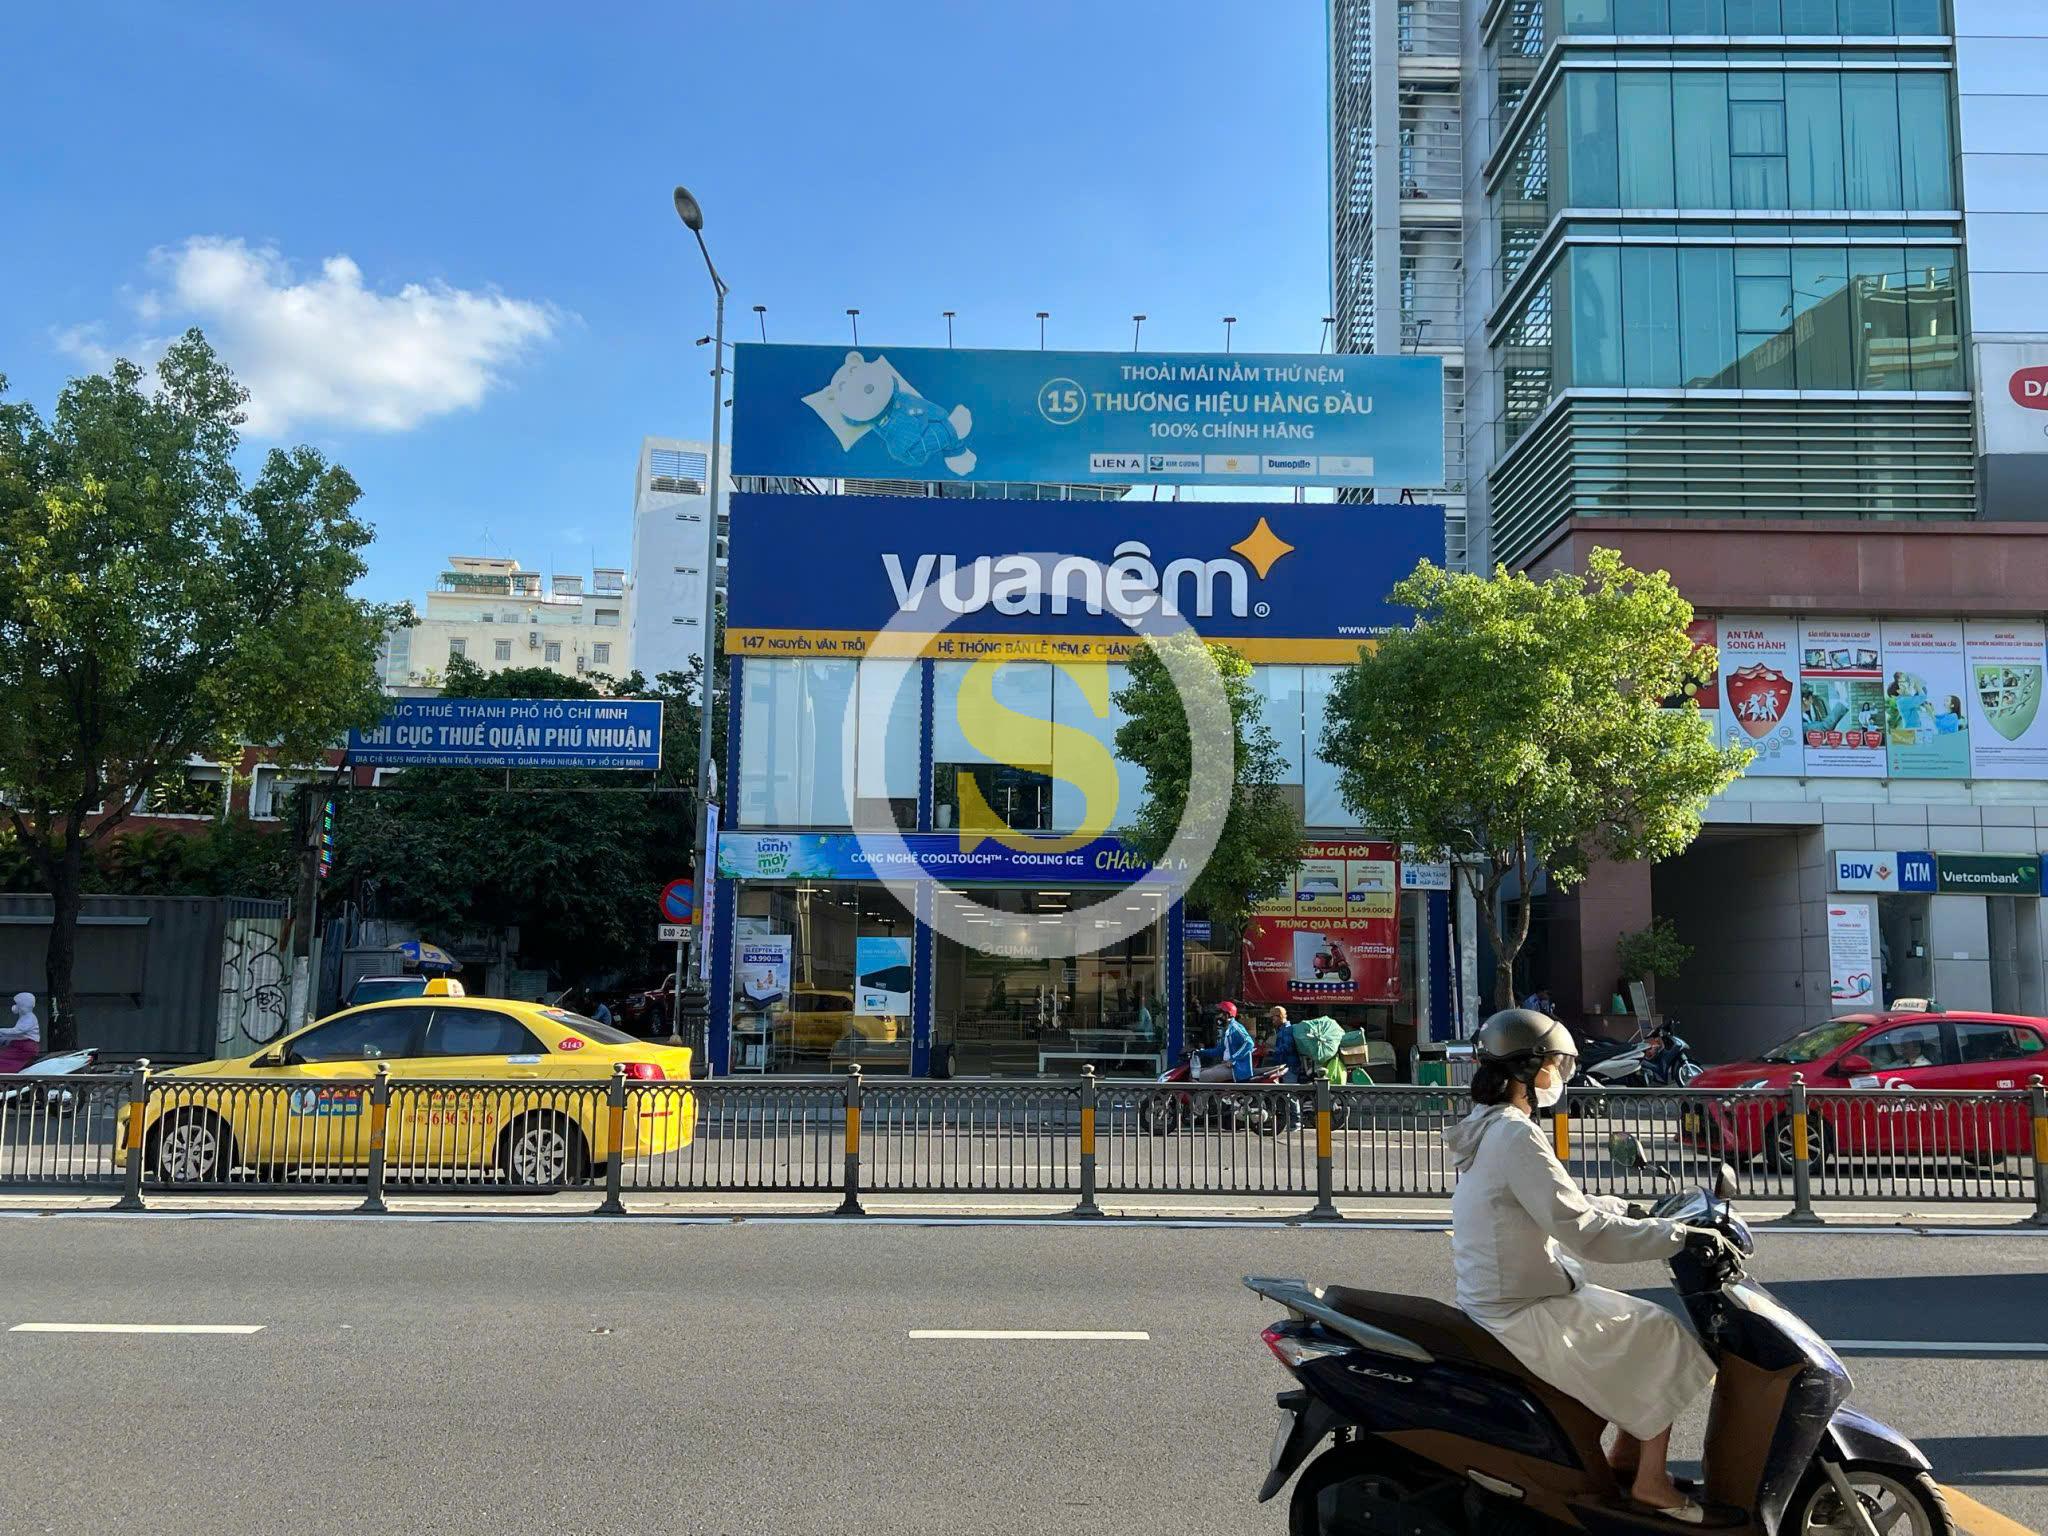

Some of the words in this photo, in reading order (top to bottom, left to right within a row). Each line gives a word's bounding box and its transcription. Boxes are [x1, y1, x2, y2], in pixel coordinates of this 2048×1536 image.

[1180, 364, 1213, 382] MÁI
[1218, 361, 1260, 382] NẰM
[1264, 364, 1302, 382] THỬ
[1304, 366, 1344, 386] NỆM
[1048, 390, 1078, 413] 15
[1092, 391, 1188, 412] THƯƠNG
[1195, 391, 1248, 416] HIỆU
[1254, 392, 1319, 414] HÀNG
[1324, 390, 1373, 414] ĐẦU
[1150, 423, 1198, 438] 100%
[1202, 421, 1258, 438] CHÍNH
[1262, 422, 1314, 439] HÃNG
[742, 636, 764, 648] 147
[768, 636, 811, 650] NGUYỄN
[816, 639, 837, 650] VĂN
[842, 637, 866, 650] TRỖI
[1727, 631, 1740, 640] AN
[1744, 630, 1764, 640] TÂM
[938, 638, 954, 654] HỆ
[958, 639, 1001, 654] THỐNG
[1052, 642, 1078, 656] NỆM
[1082, 645, 1090, 654] &
[1727, 642, 1755, 650] SONG
[1758, 640, 1786, 650] HÀNH
[417, 702, 453, 717] THUẾ
[458, 704, 506, 718] THÀNH
[510, 703, 539, 718] PHỐ
[544, 704, 564, 718] HỒ
[568, 704, 591, 719] CHÍ
[595, 708, 628, 720] MINH
[396, 726, 433, 748] CỤC
[438, 722, 485, 746] THUẾ
[488, 725, 540, 749] QUẬN
[545, 725, 582, 747] PHÚ
[586, 726, 652, 750] NHUẬN
[850, 851, 884, 862] CÔNG
[887, 852, 918, 865] NGHỆ
[1012, 854, 1063, 865] COOLING
[1066, 856, 1084, 865] ICE
[1327, 846, 1348, 856] GIÁ
[1348, 845, 1369, 858] HỜI
[1840, 864, 1873, 880] BIDV
[1904, 862, 1930, 882] ATM
[1942, 870, 2019, 884] Vietcombank
[1275, 918, 1307, 929] TRÚNG
[1310, 918, 1332, 929] QUÀ
[1348, 1365, 1414, 1383] LEAD
